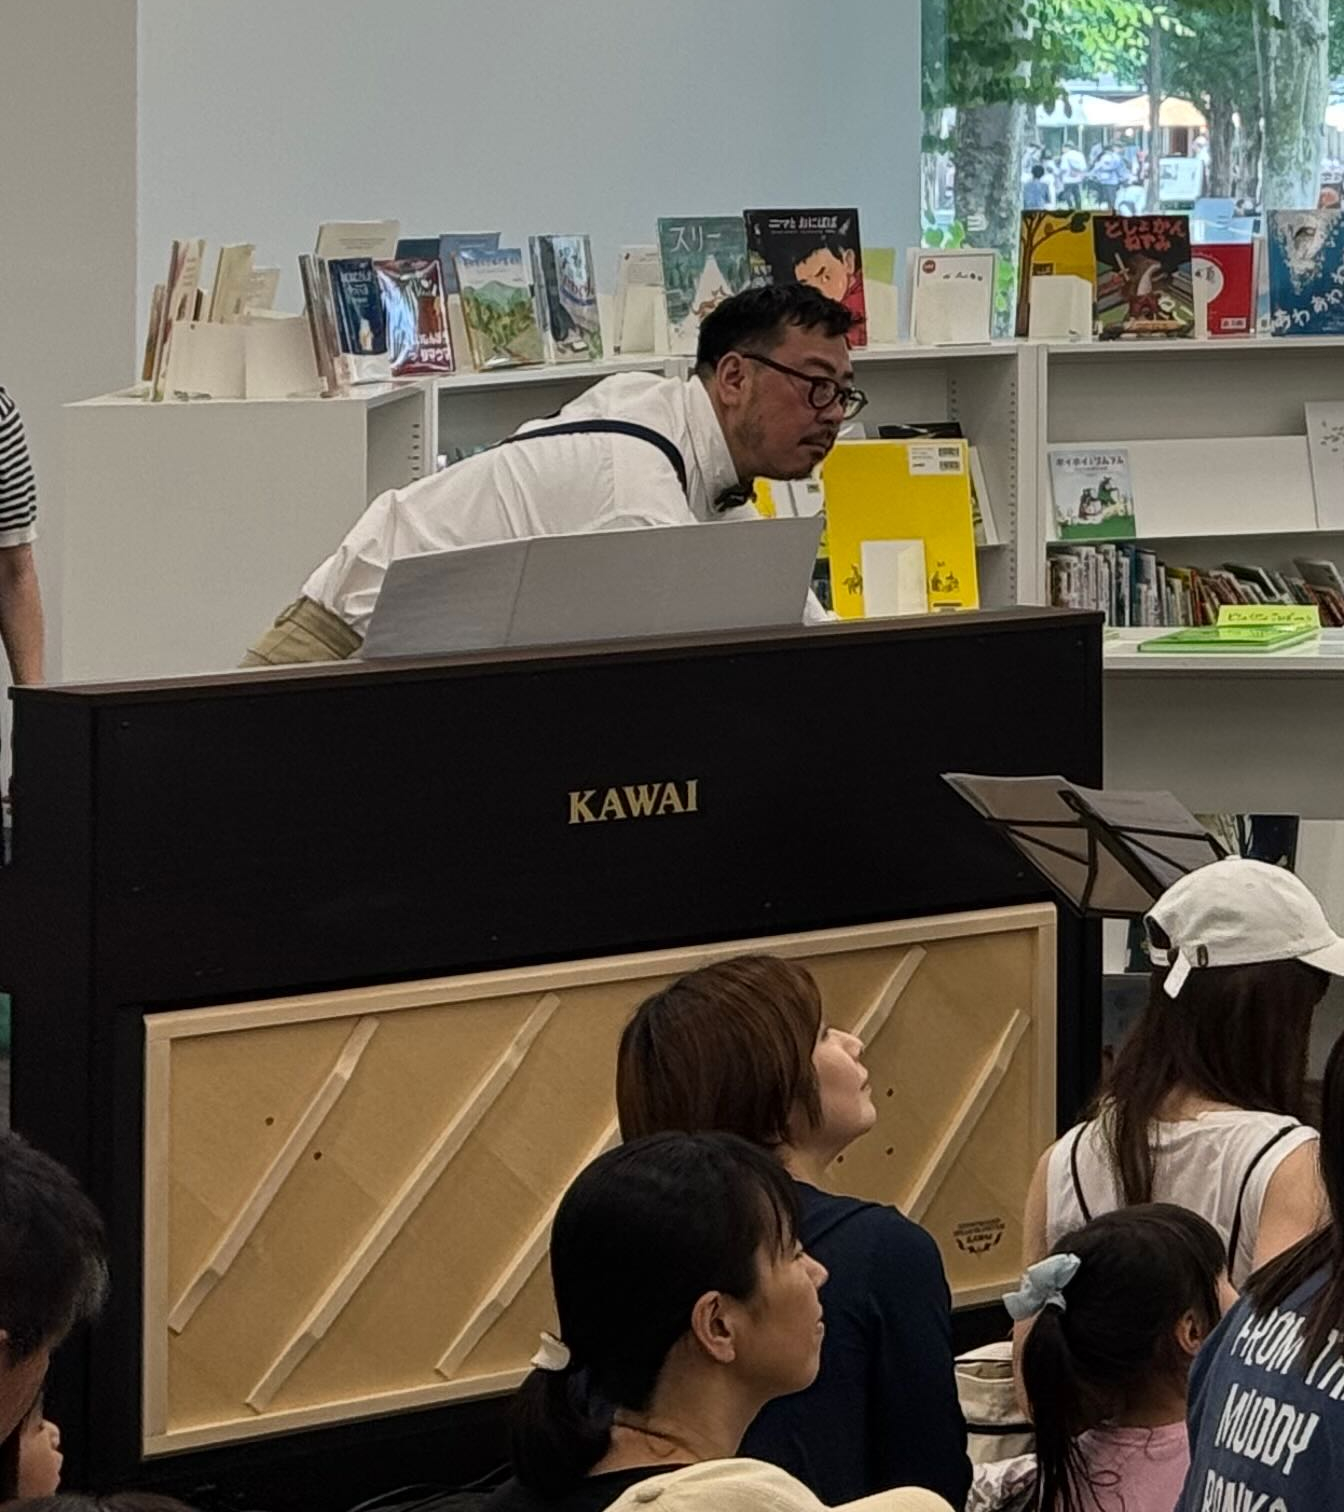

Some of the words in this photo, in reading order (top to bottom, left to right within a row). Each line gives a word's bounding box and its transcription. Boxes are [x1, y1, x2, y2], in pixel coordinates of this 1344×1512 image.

[669, 226, 721, 252] スリー
[1103, 219, 1185, 238] としょかん
[568, 779, 698, 824] KAWAI
[1230, 1306, 1306, 1375] FROM
[1214, 1383, 1320, 1476] MUDDY
